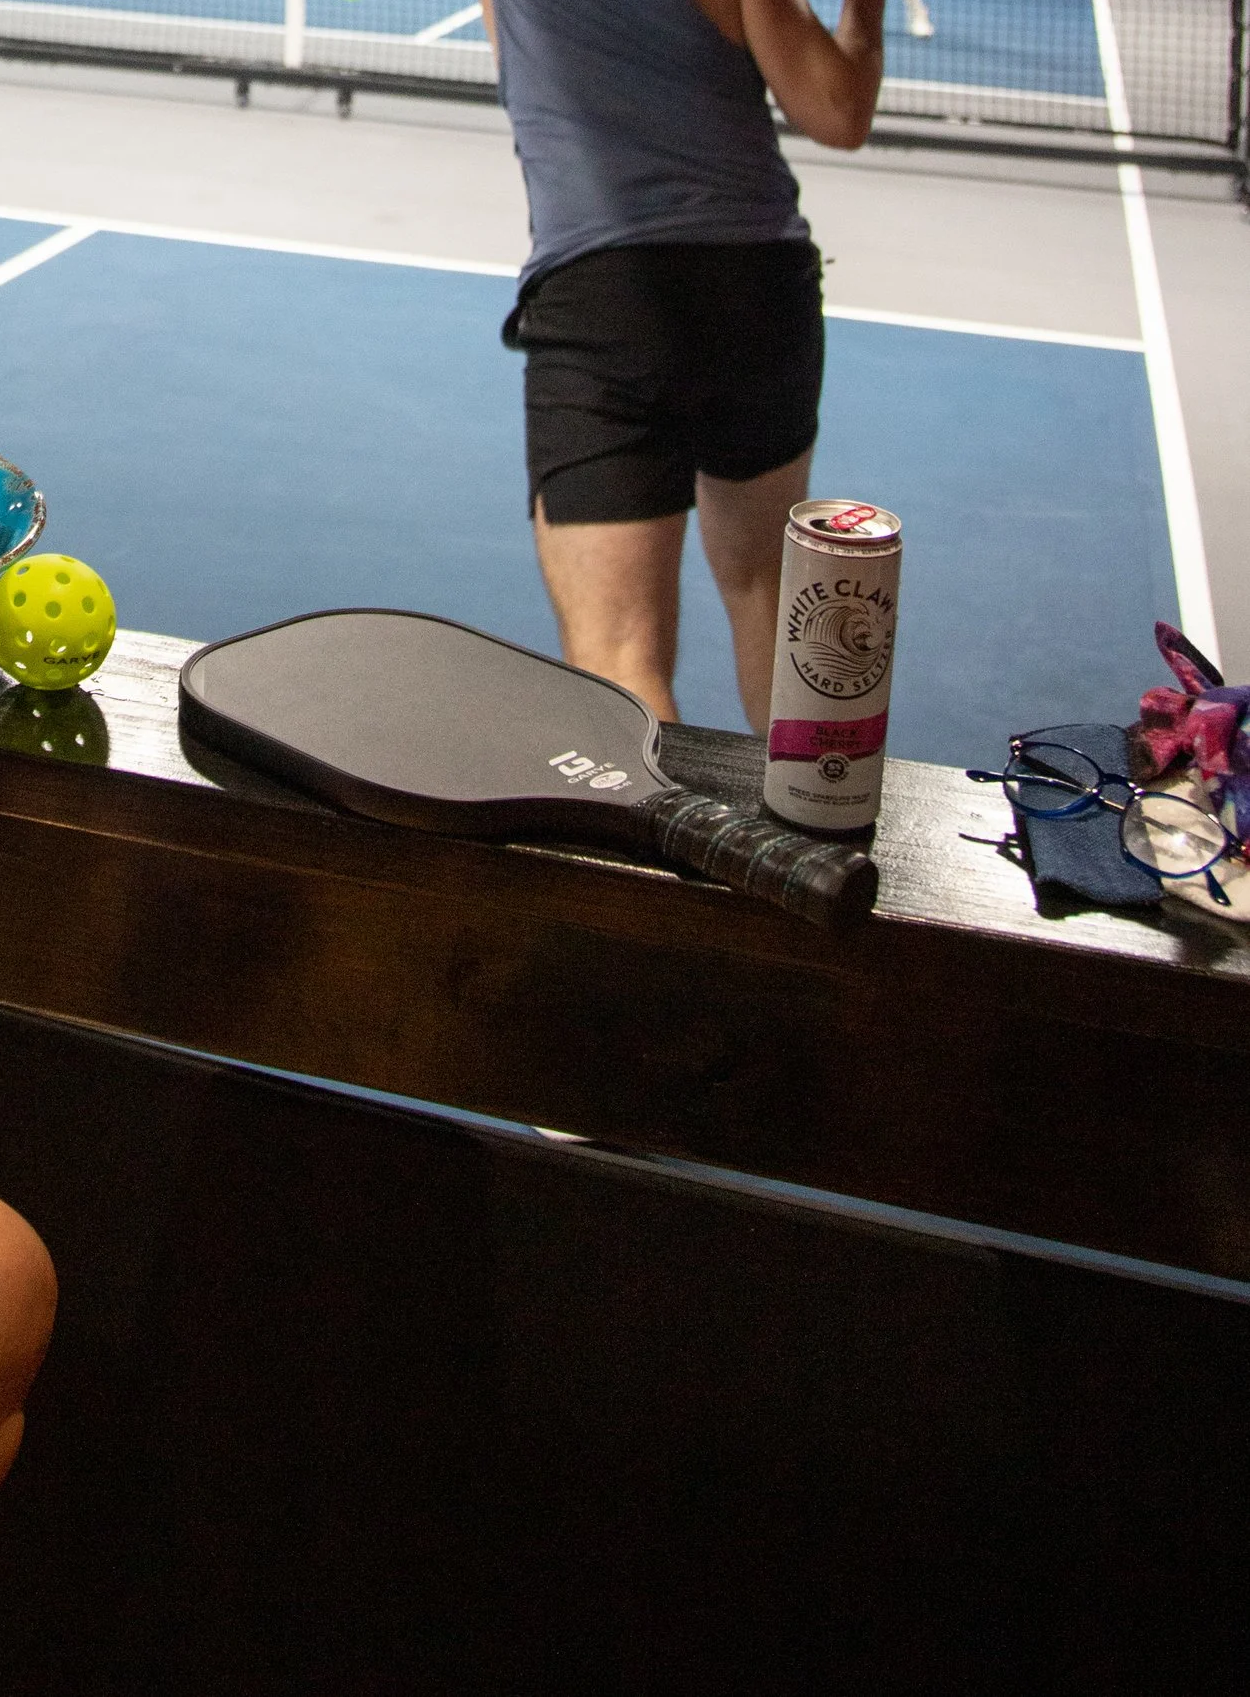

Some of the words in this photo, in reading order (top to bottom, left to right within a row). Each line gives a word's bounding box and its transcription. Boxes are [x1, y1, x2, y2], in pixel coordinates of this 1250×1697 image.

[788, 582, 829, 642] WHITE
[834, 579, 894, 613] CLAW
[801, 662, 844, 692] HARD
[852, 630, 892, 692] SELTZER
[815, 725, 857, 738] BLACK
